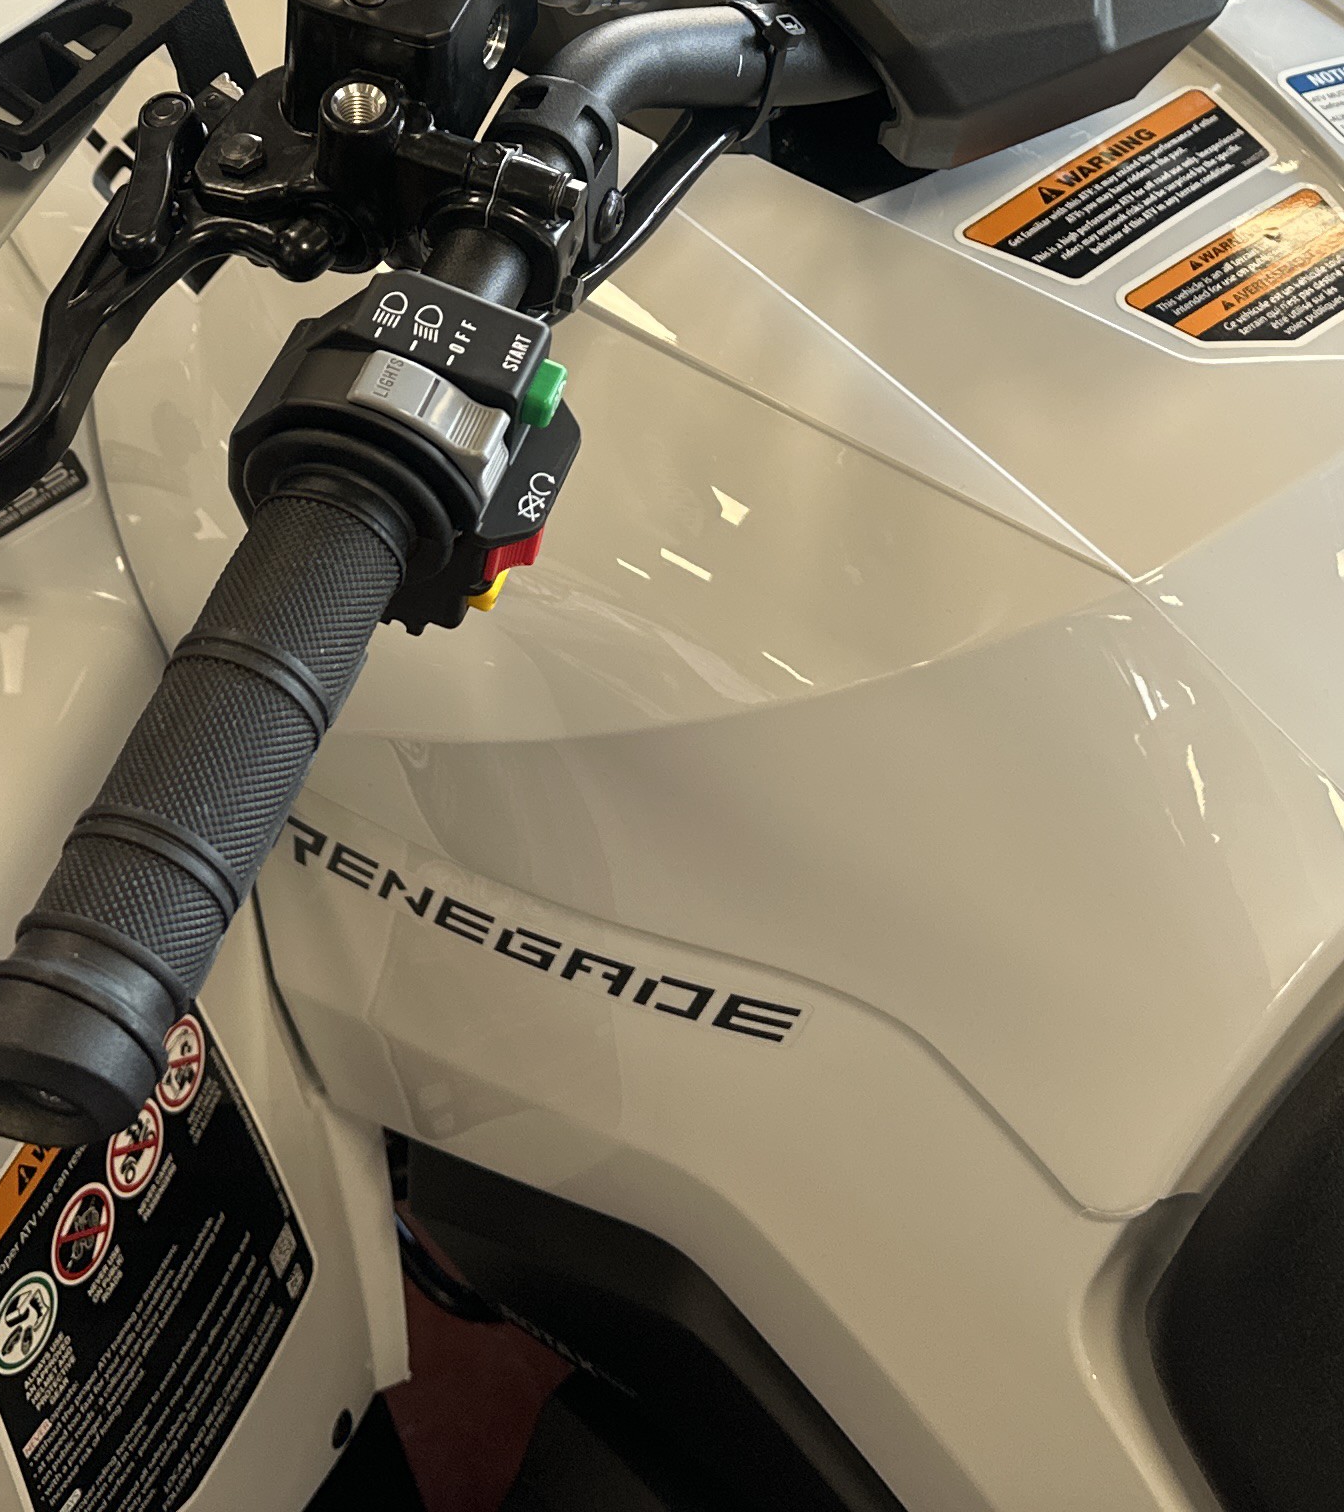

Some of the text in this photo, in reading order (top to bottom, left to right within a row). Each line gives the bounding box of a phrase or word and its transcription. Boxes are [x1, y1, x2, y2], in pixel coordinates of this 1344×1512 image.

[1056, 123, 1157, 192] WARNING
[1194, 126, 1244, 160] Inexperienced
[1006, 233, 1025, 248] Get
[1019, 216, 1052, 239] familiar
[1047, 205, 1069, 221] with
[1063, 196, 1082, 211] this
[1092, 182, 1104, 192] it
[1099, 173, 1119, 188] may
[1113, 158, 1141, 179] exceed
[1136, 151, 1153, 164] the
[1148, 128, 1193, 157] performance
[1189, 123, 1201, 133] of
[1196, 113, 1219, 128] other
[1063, 144, 1189, 224] ATVs you may have ridden in the past.
[1141, 179, 1156, 192] off
[1151, 169, 1171, 185] road
[1167, 162, 1183, 175] use
[1058, 241, 1084, 261] riders
[1079, 231, 1099, 247] may
[1094, 212, 1128, 237] overlook
[1123, 201, 1145, 217] risks
[1140, 192, 1158, 206] and
[1153, 186, 1167, 198] be
[1161, 168, 1197, 193] surprised
[1192, 163, 1207, 174] by
[1201, 156, 1218, 169] the
[1213, 142, 1242, 162] specific
[1088, 159, 1236, 255] behavior of this ATV in any terrain condition.
[1117, 193, 1135, 207] ATV
[1130, 186, 1146, 199] for
[1057, 229, 1080, 246] high
[1074, 201, 1123, 235] performance
[1030, 248, 1051, 264] This
[1045, 243, 1058, 254] is
[1052, 240, 1064, 250] a
[1155, 296, 1177, 313] This
[1172, 279, 1205, 302] vehicle
[1201, 274, 1212, 285] is
[1208, 267, 1224, 280] an
[1220, 261, 1233, 273] all
[1229, 246, 1259, 267] terrain
[1170, 288, 1211, 316] intended
[1206, 281, 1222, 294] for
[1219, 272, 1238, 287] use
[1234, 265, 1250, 278] on
[1221, 317, 1238, 331] Ce
[1234, 298, 1270, 323] véhicule
[1267, 290, 1284, 304] est
[1280, 283, 1295, 296] un
[1292, 264, 1327, 289] véhicule
[1236, 314, 1269, 337] terrain
[1265, 305, 1283, 320] qui
[1297, 285, 1315, 300] pas
[1311, 268, 1343, 291] destiné
[1268, 283, 1339, 330] être utilisé sur les
[453, 319, 478, 355] OFF
[1281, 316, 1308, 336] voies
[502, 334, 532, 372] START
[372, 357, 405, 399] LIGHTS
[287, 814, 804, 1043] RENEGADE
[17, 1210, 38, 1245] ATV
[35, 1188, 53, 1219] use
[51, 1165, 69, 1196] can
[23, 1328, 65, 1392] ALWAYS USE
[24, 1331, 71, 1402] AN APPROVED
[30, 1343, 73, 1407] HELMET AND
[35, 1351, 76, 1413] PROTECTIVE
[48, 1374, 69, 1407] GEAR
[23, 1418, 50, 1458] NEVER
